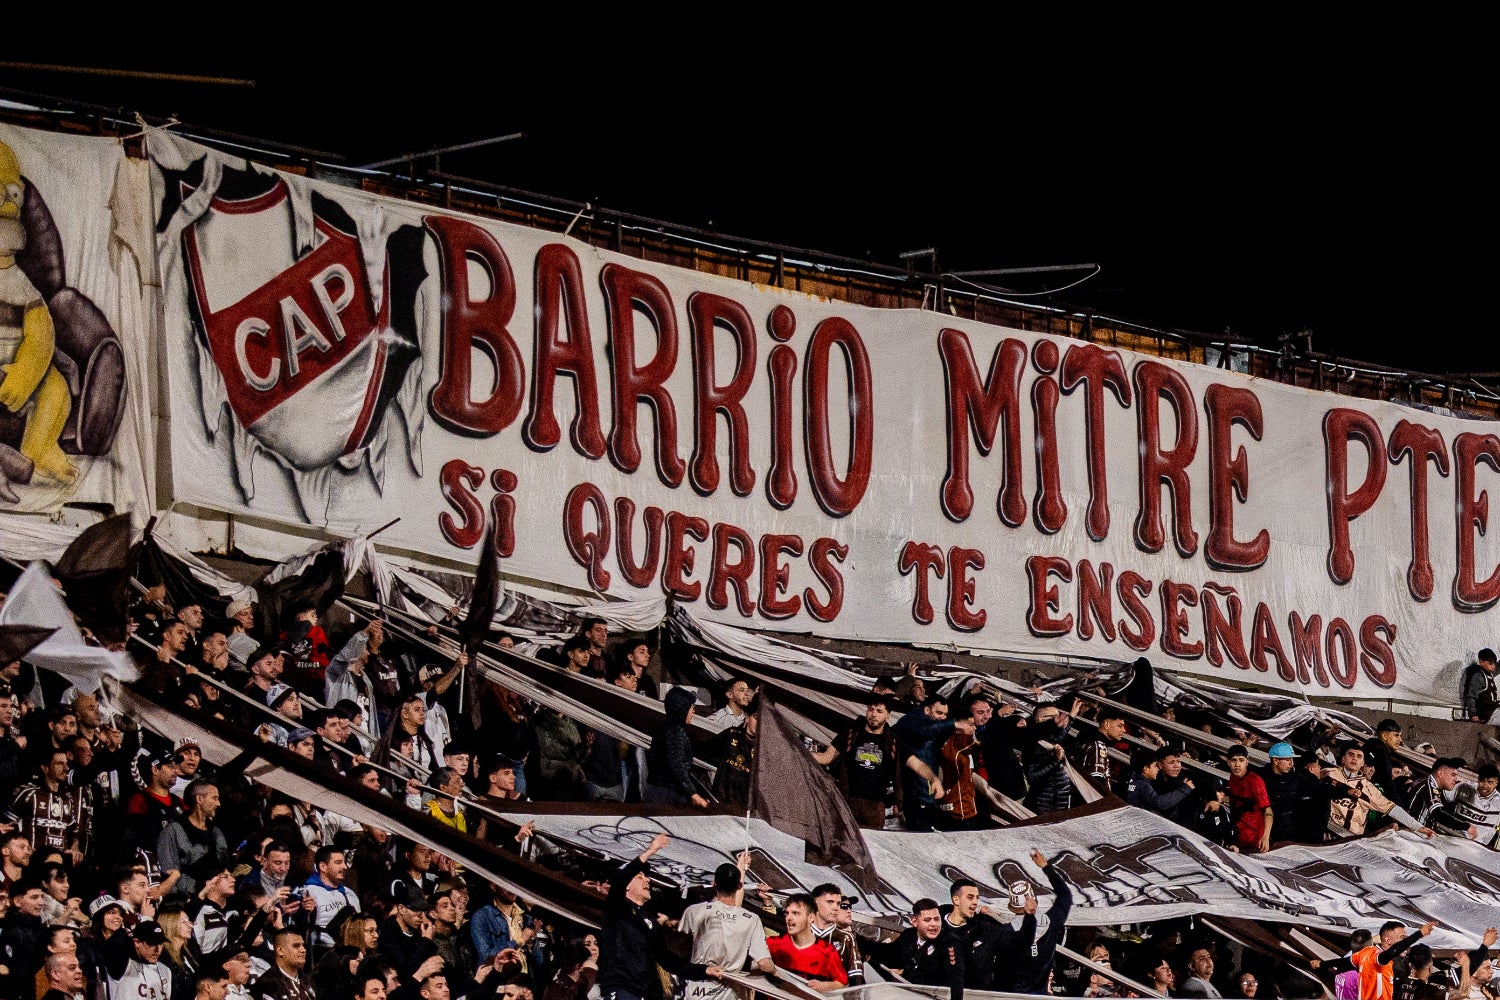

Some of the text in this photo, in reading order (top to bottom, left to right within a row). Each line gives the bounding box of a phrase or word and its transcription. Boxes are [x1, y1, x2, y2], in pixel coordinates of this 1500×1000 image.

[234, 263, 356, 392] CAP
[564, 482, 849, 622] QUERES
[900, 541, 987, 632] TE
[1026, 555, 1398, 690] ENSEÑAMOS
